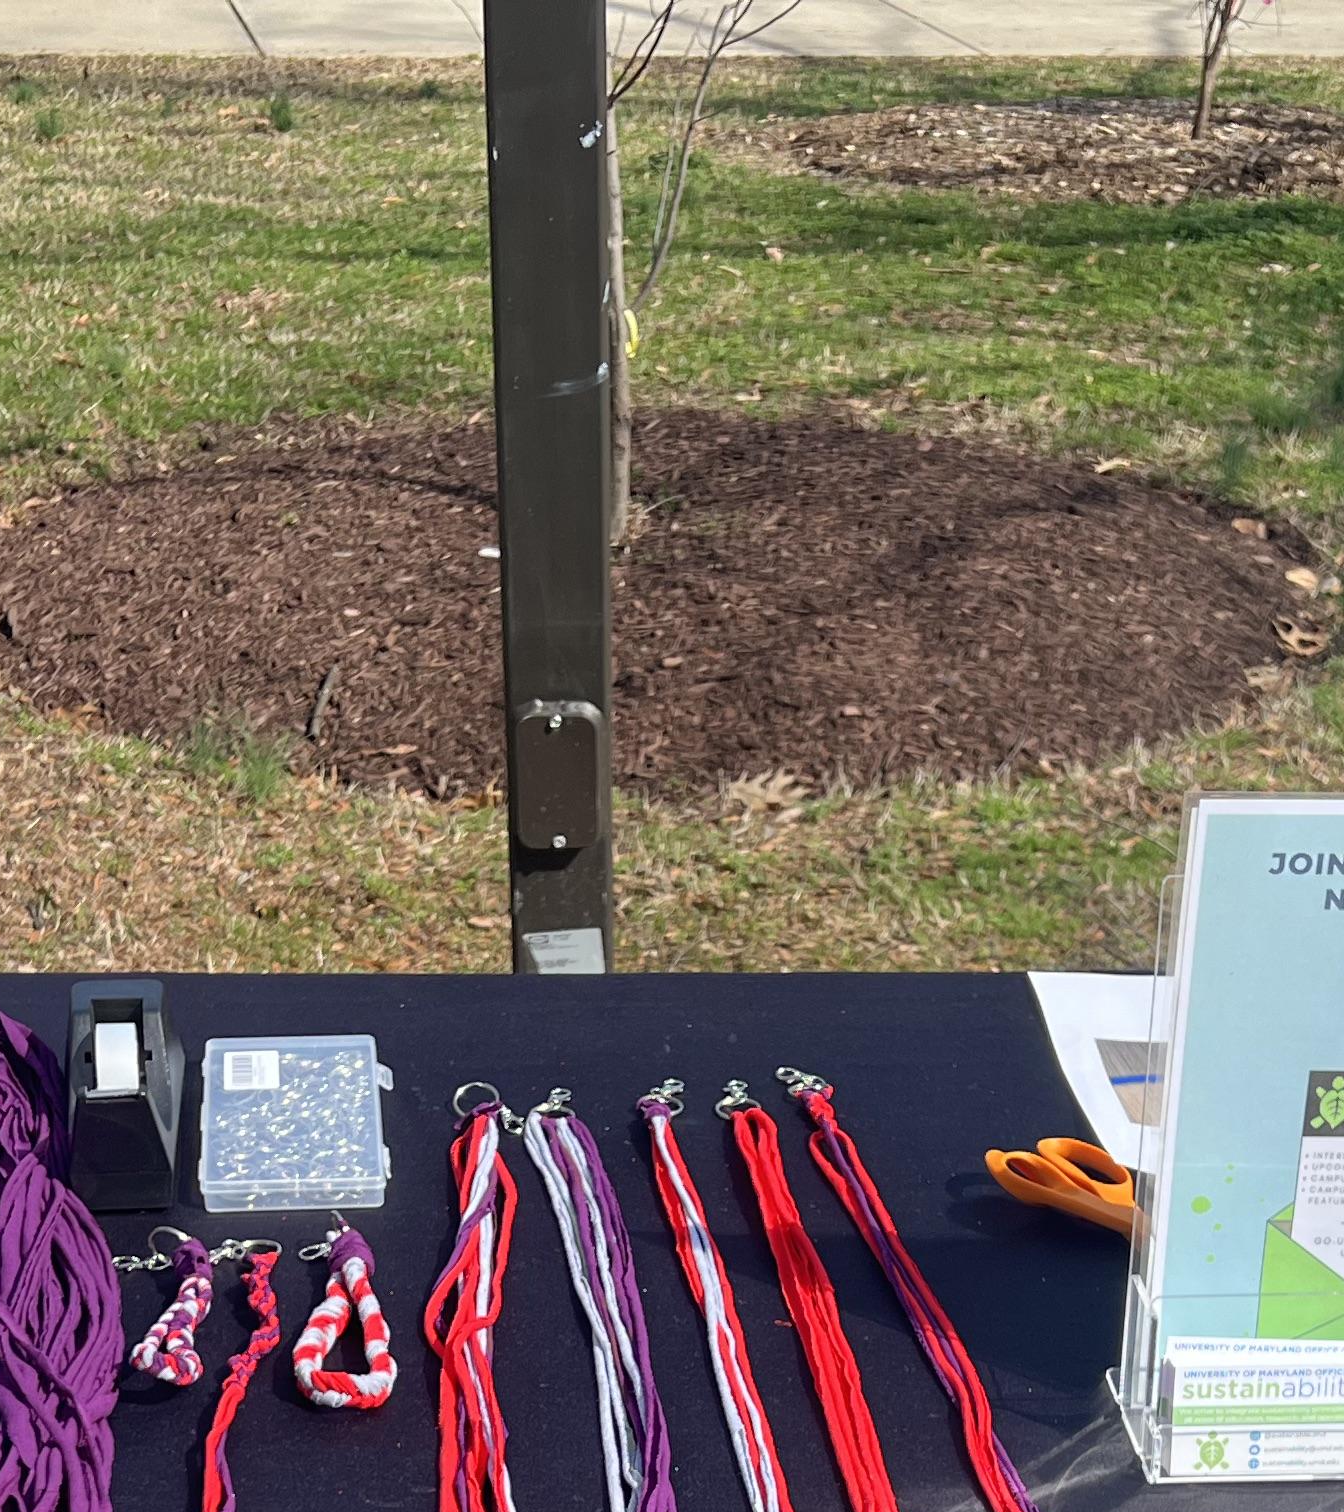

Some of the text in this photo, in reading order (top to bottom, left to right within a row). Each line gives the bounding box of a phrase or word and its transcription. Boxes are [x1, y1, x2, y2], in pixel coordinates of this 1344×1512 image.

[1175, 1343, 1230, 1351] UNIVERSITY
[1233, 1344, 1246, 1352] OF
[1248, 1345, 1302, 1353] MARYLAND
[1184, 1370, 1240, 1379] UNIVERSITY
[1242, 1369, 1256, 1378] OF
[1259, 1369, 1313, 1378] MARYLAND
